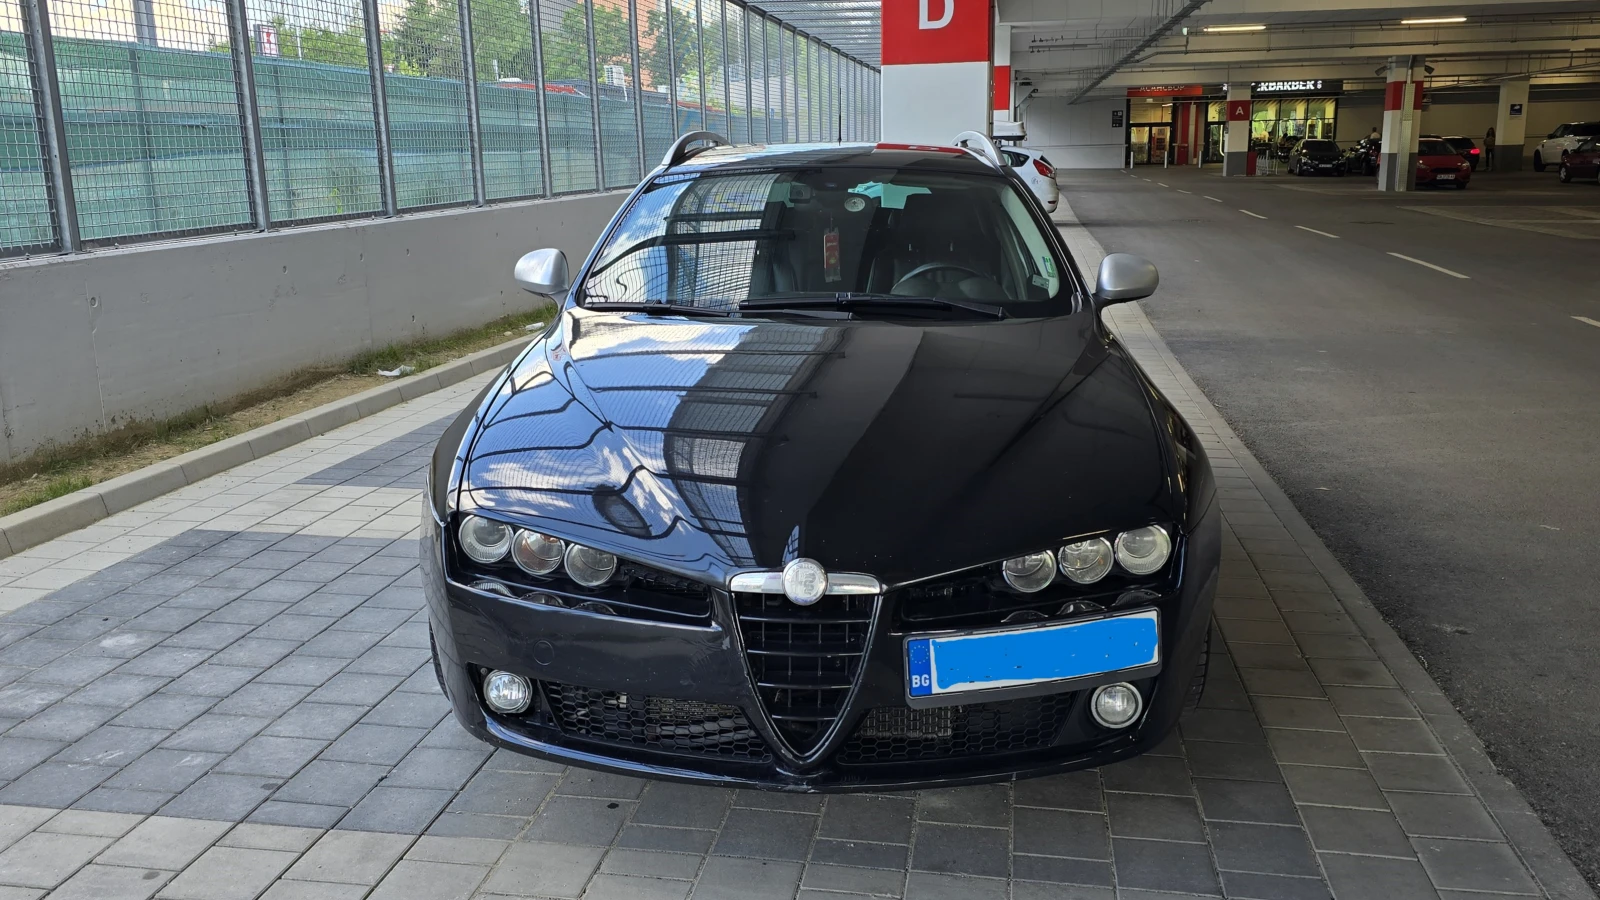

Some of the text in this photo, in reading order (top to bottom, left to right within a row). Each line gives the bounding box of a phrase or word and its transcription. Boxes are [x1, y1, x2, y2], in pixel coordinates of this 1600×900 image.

[918, 0, 954, 30] D
[1235, 106, 1244, 115] A
[911, 674, 930, 688] BG
